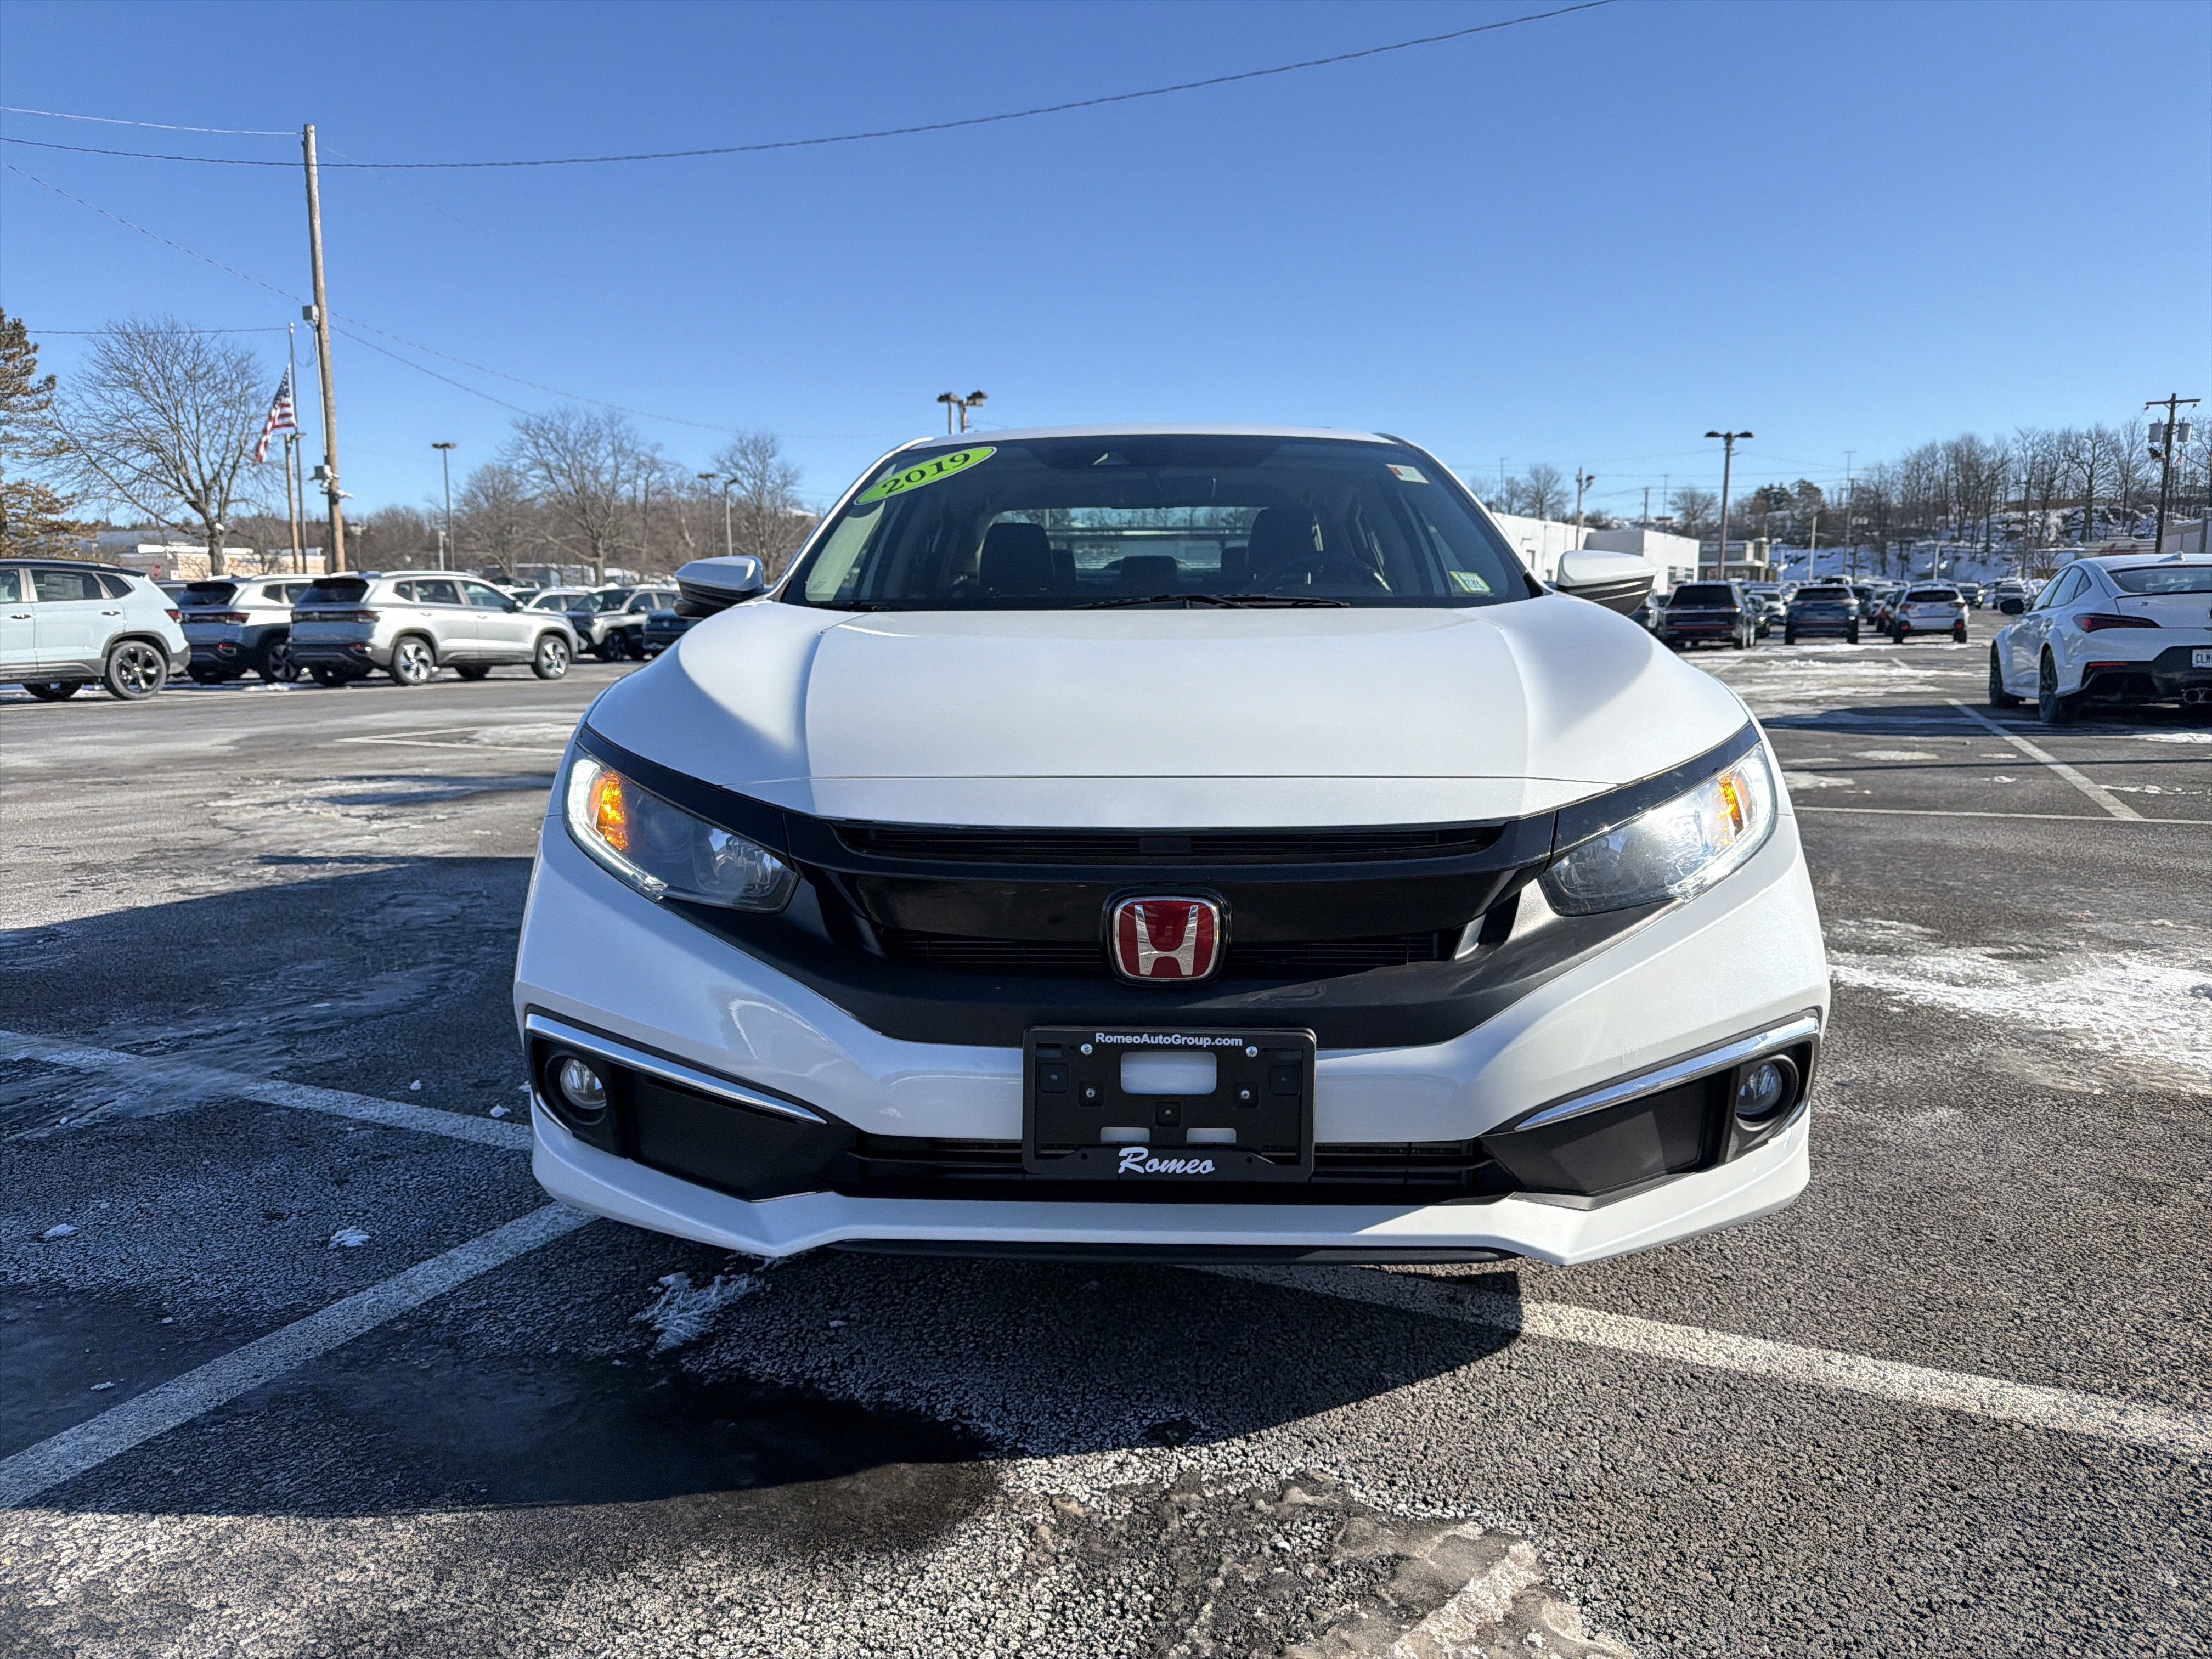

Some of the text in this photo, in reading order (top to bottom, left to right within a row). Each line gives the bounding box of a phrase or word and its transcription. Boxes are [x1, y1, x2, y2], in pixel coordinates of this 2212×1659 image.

[882, 453, 970, 494] 2019
[1096, 1032, 1243, 1047] RomeoAutoGroup.com
[1118, 1147, 1215, 1174] Romeo
